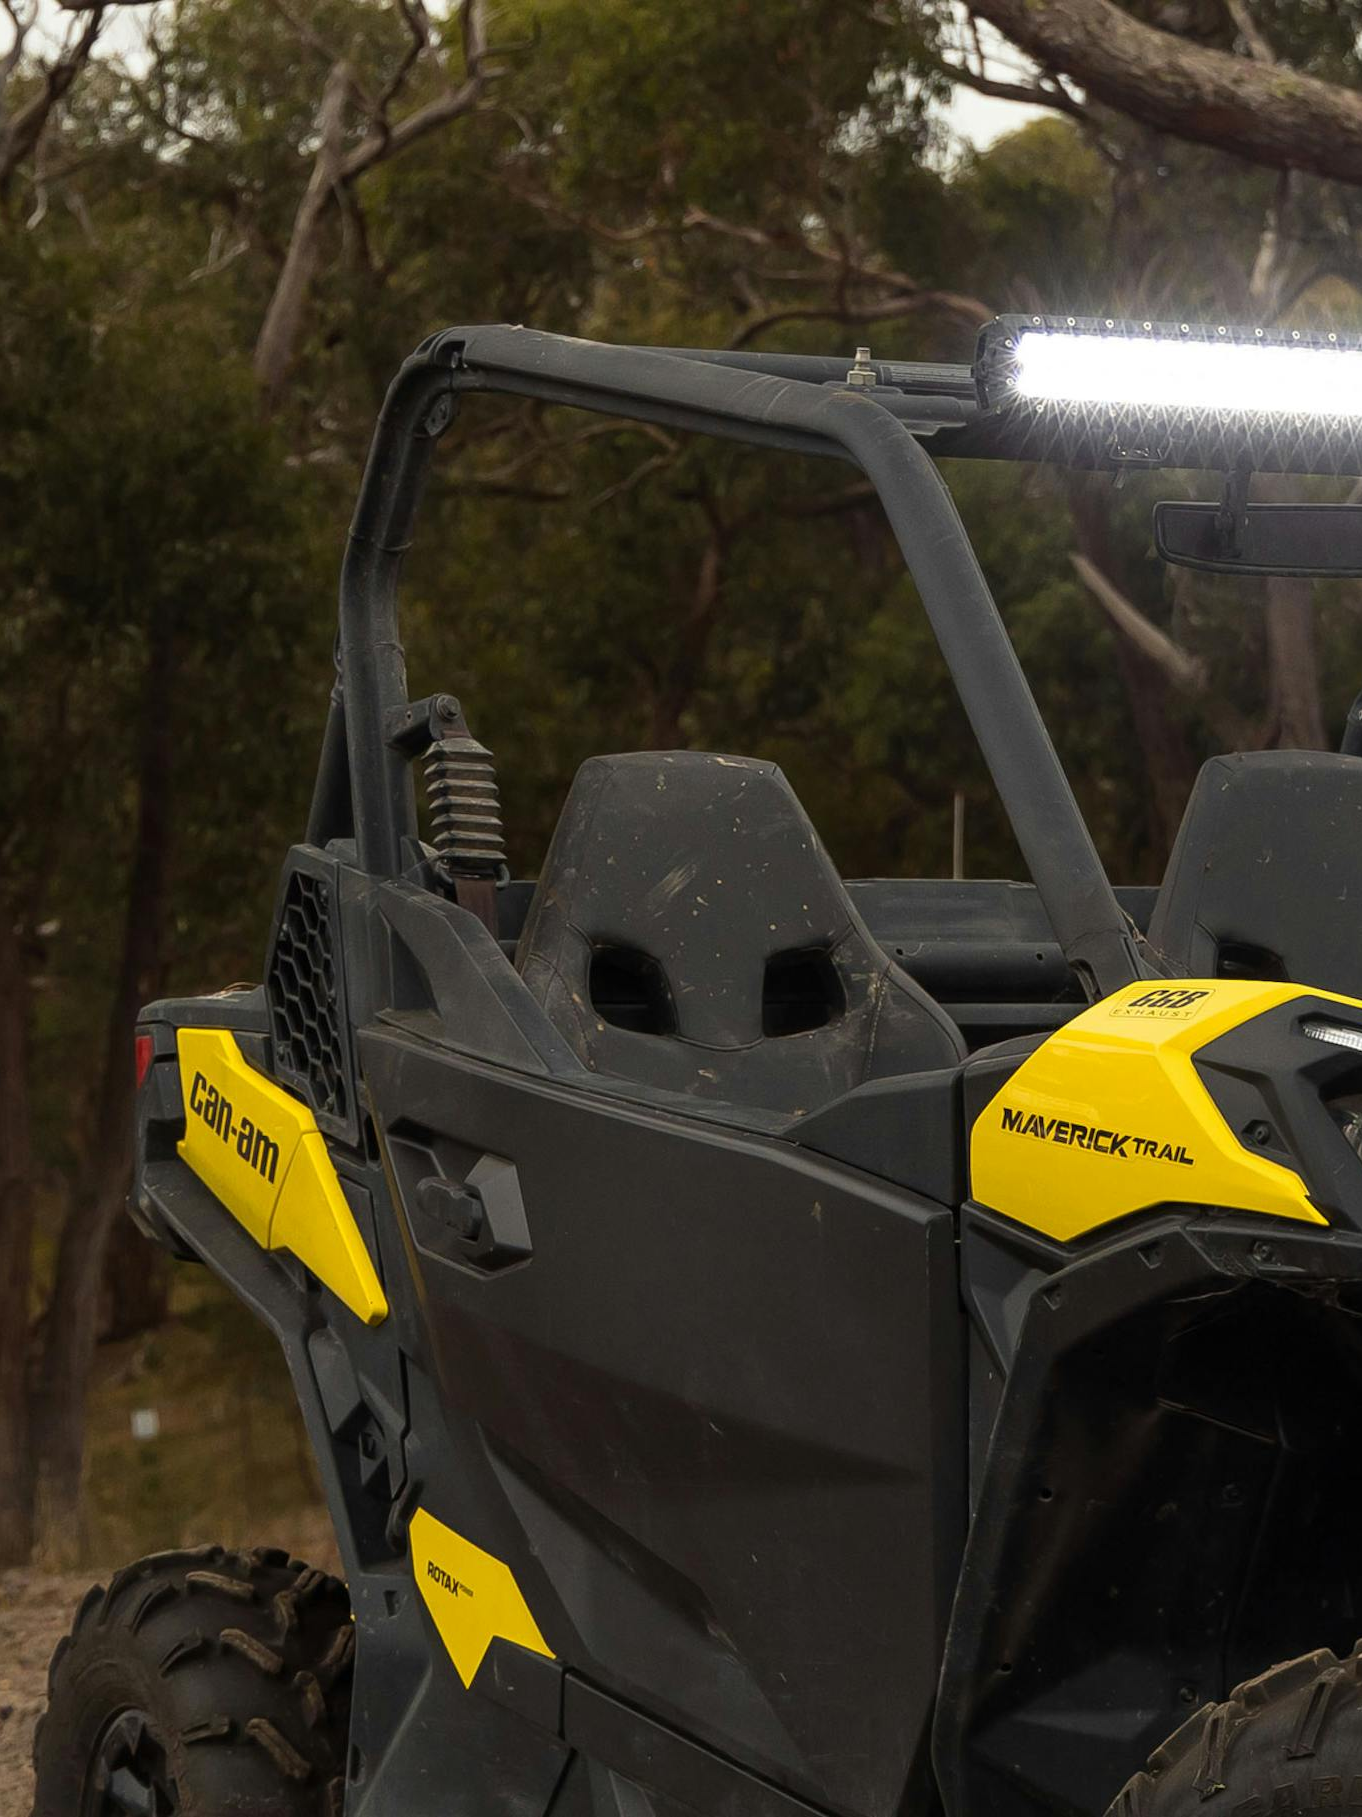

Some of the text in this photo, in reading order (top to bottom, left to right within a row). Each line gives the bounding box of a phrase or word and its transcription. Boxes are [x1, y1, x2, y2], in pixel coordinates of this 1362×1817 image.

[1113, 1009, 1193, 1017] EXHAUST
[1128, 990, 1210, 1009] GGB
[190, 1071, 279, 1184] can-am
[1001, 1108, 1194, 1166] MAVERICK TRAIL
[427, 1560, 459, 1597] ROTAX
